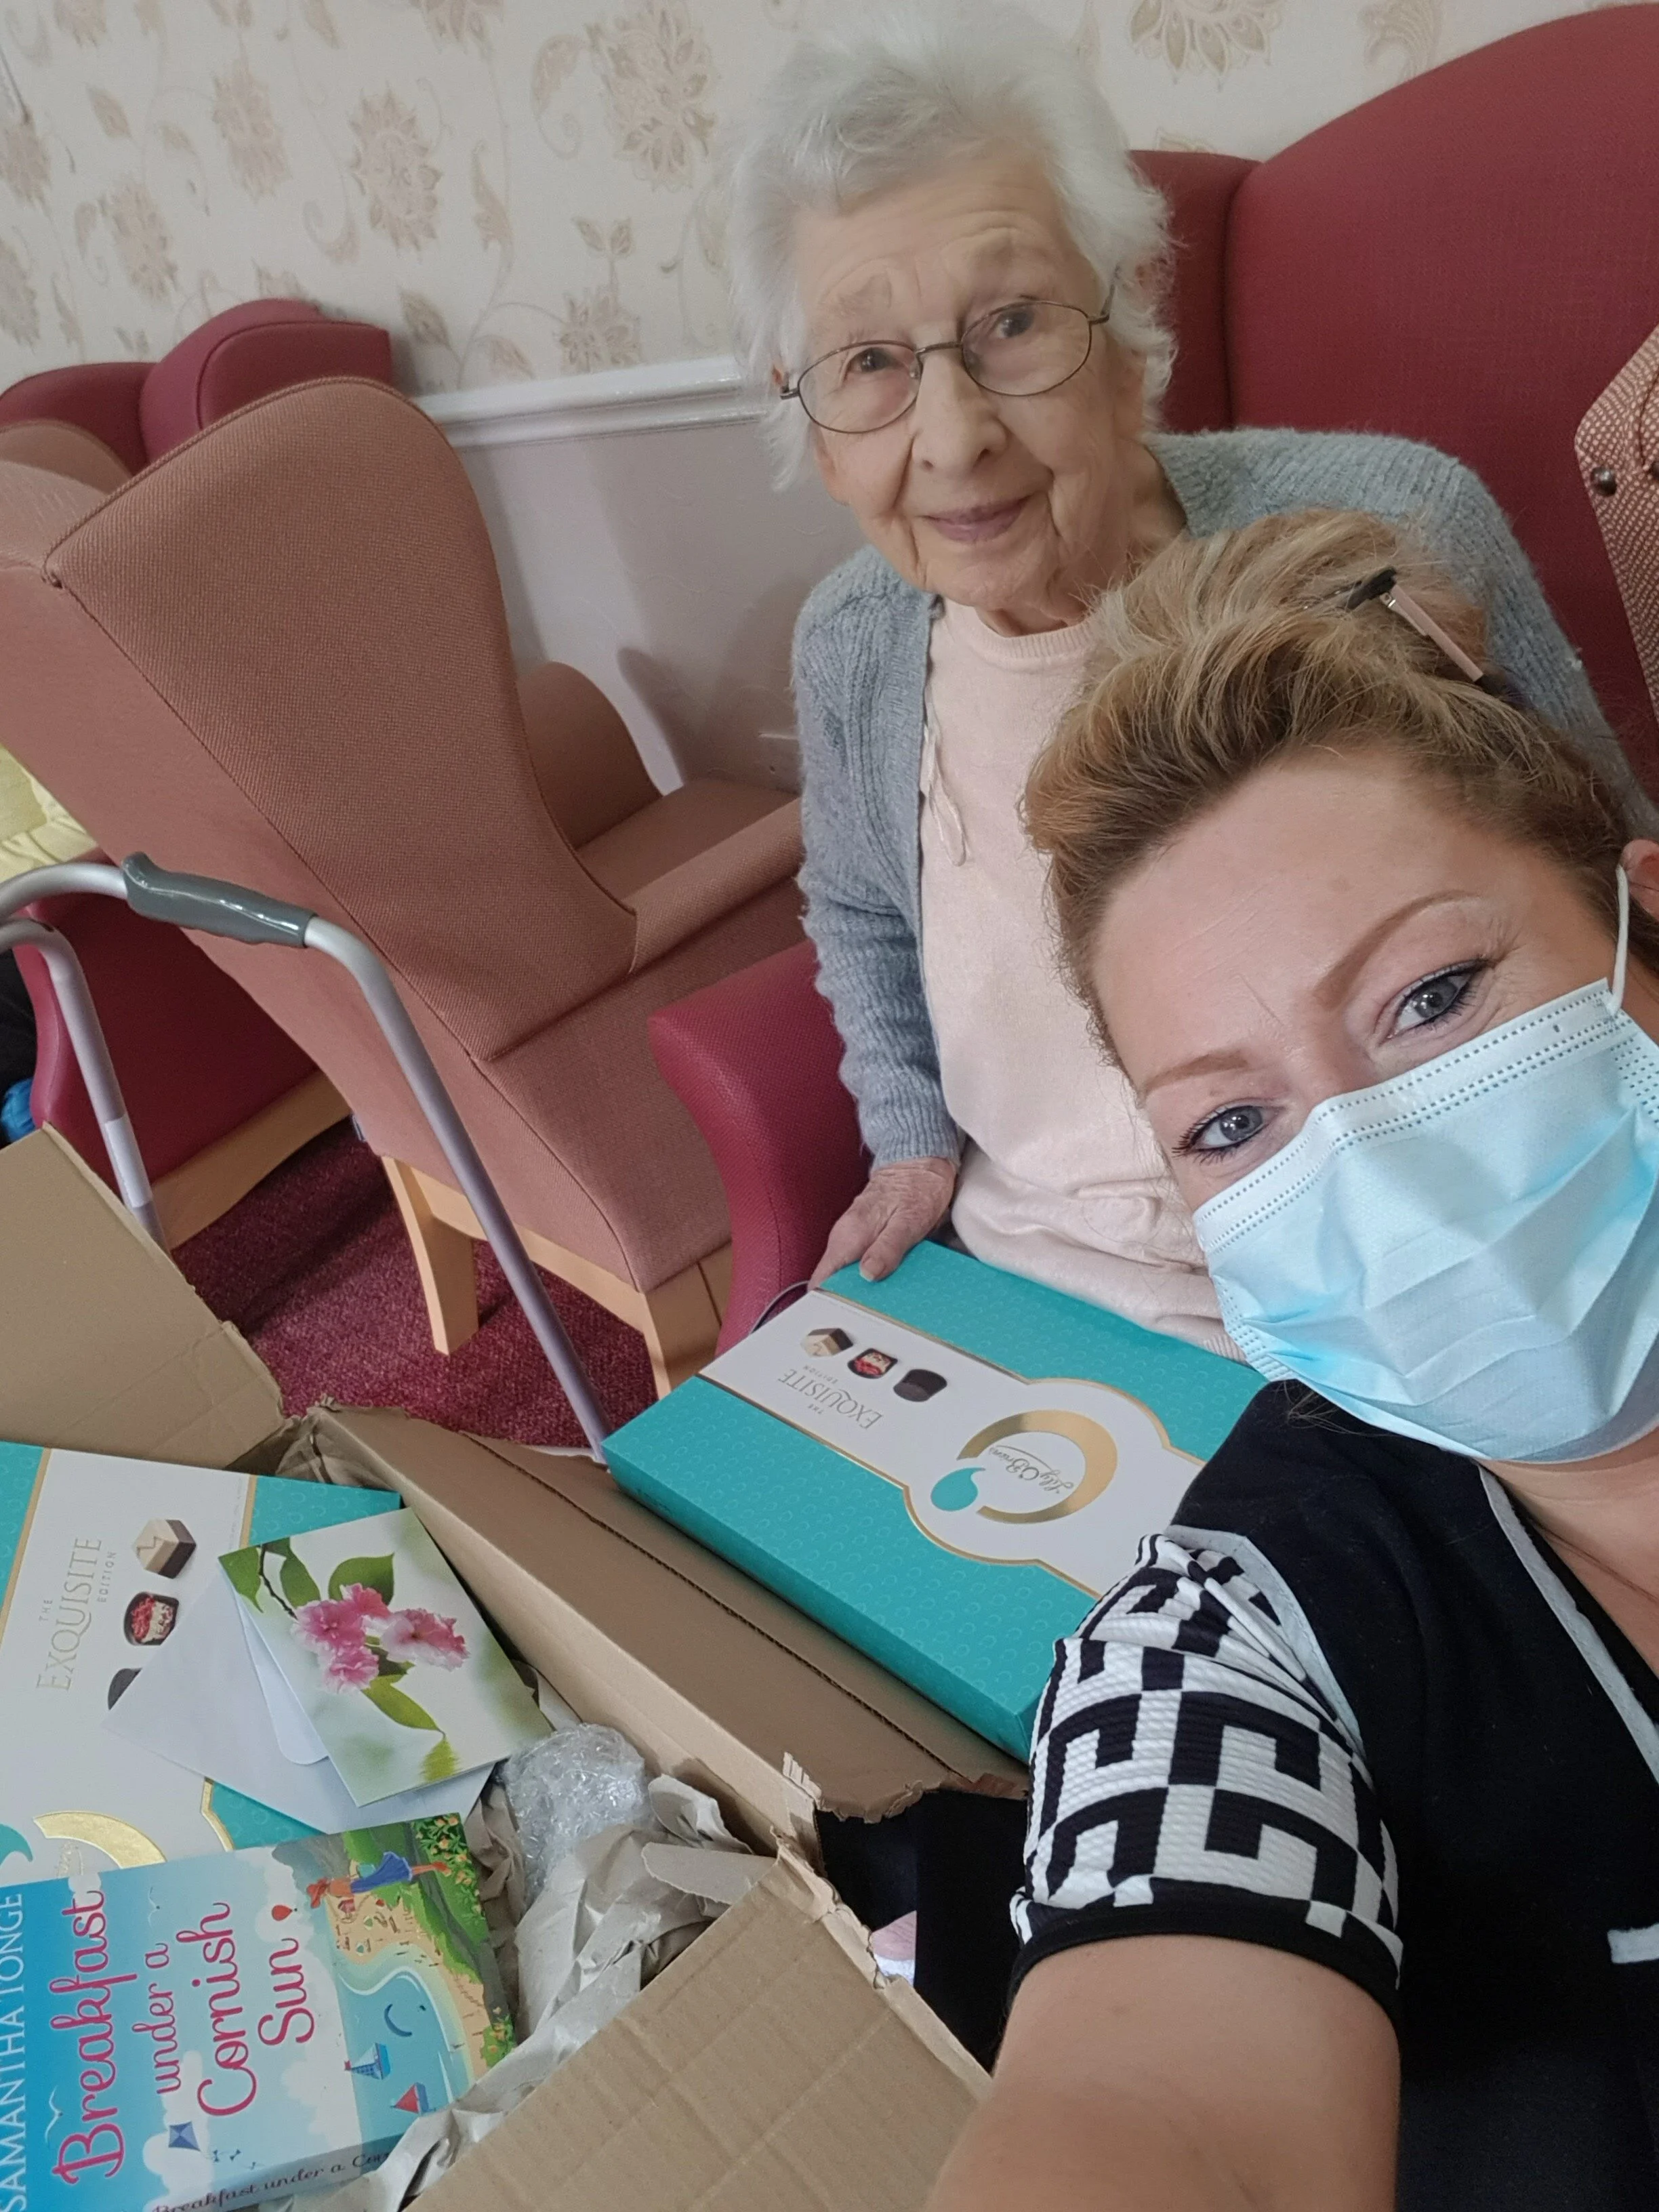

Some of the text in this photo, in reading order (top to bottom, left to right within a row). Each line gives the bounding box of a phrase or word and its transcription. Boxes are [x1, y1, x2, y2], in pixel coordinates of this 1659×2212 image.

[777, 1368, 883, 1430] EXQUISITE
[36, 1538, 102, 1692] EXQUISITE
[39, 1599, 54, 1622] THE
[96, 1551, 117, 1603] EDITION
[49, 1889, 138, 2186] Breakfast
[131, 1942, 182, 2094] under a
[176, 1902, 258, 2116] Cornish
[258, 1937, 315, 2047] Sun
[264, 2168, 324, 2190] under
